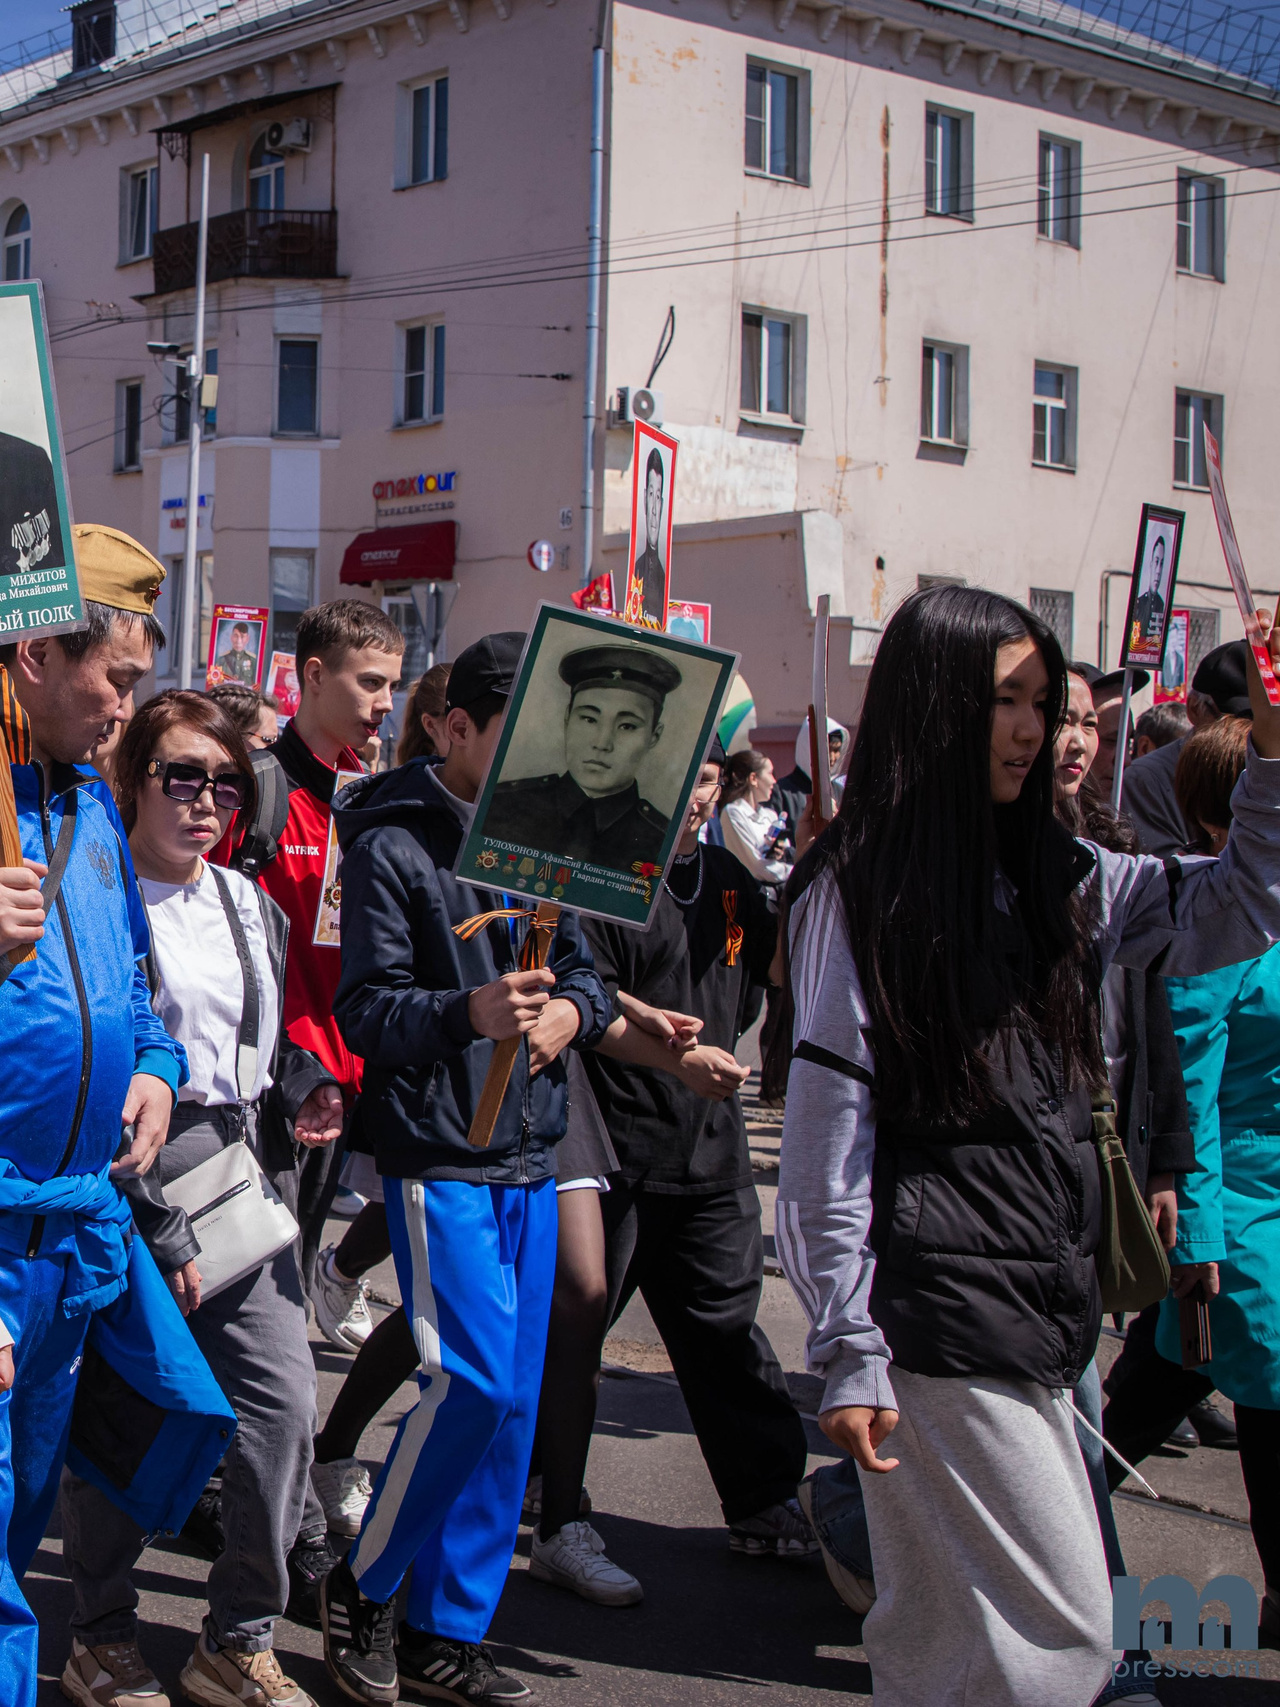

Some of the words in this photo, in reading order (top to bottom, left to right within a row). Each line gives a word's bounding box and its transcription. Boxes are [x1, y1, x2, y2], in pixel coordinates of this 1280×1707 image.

[372, 470, 456, 500] anextour
[10, 569, 67, 587] МИЖИТОВ
[9, 582, 69, 599] Михайлович
[28, 604, 76, 628] ПОЛК
[483, 837, 539, 857] ТУЛОХОНОВ
[541, 852, 581, 869] Афанасий
[572, 870, 606, 887] Гвардии
